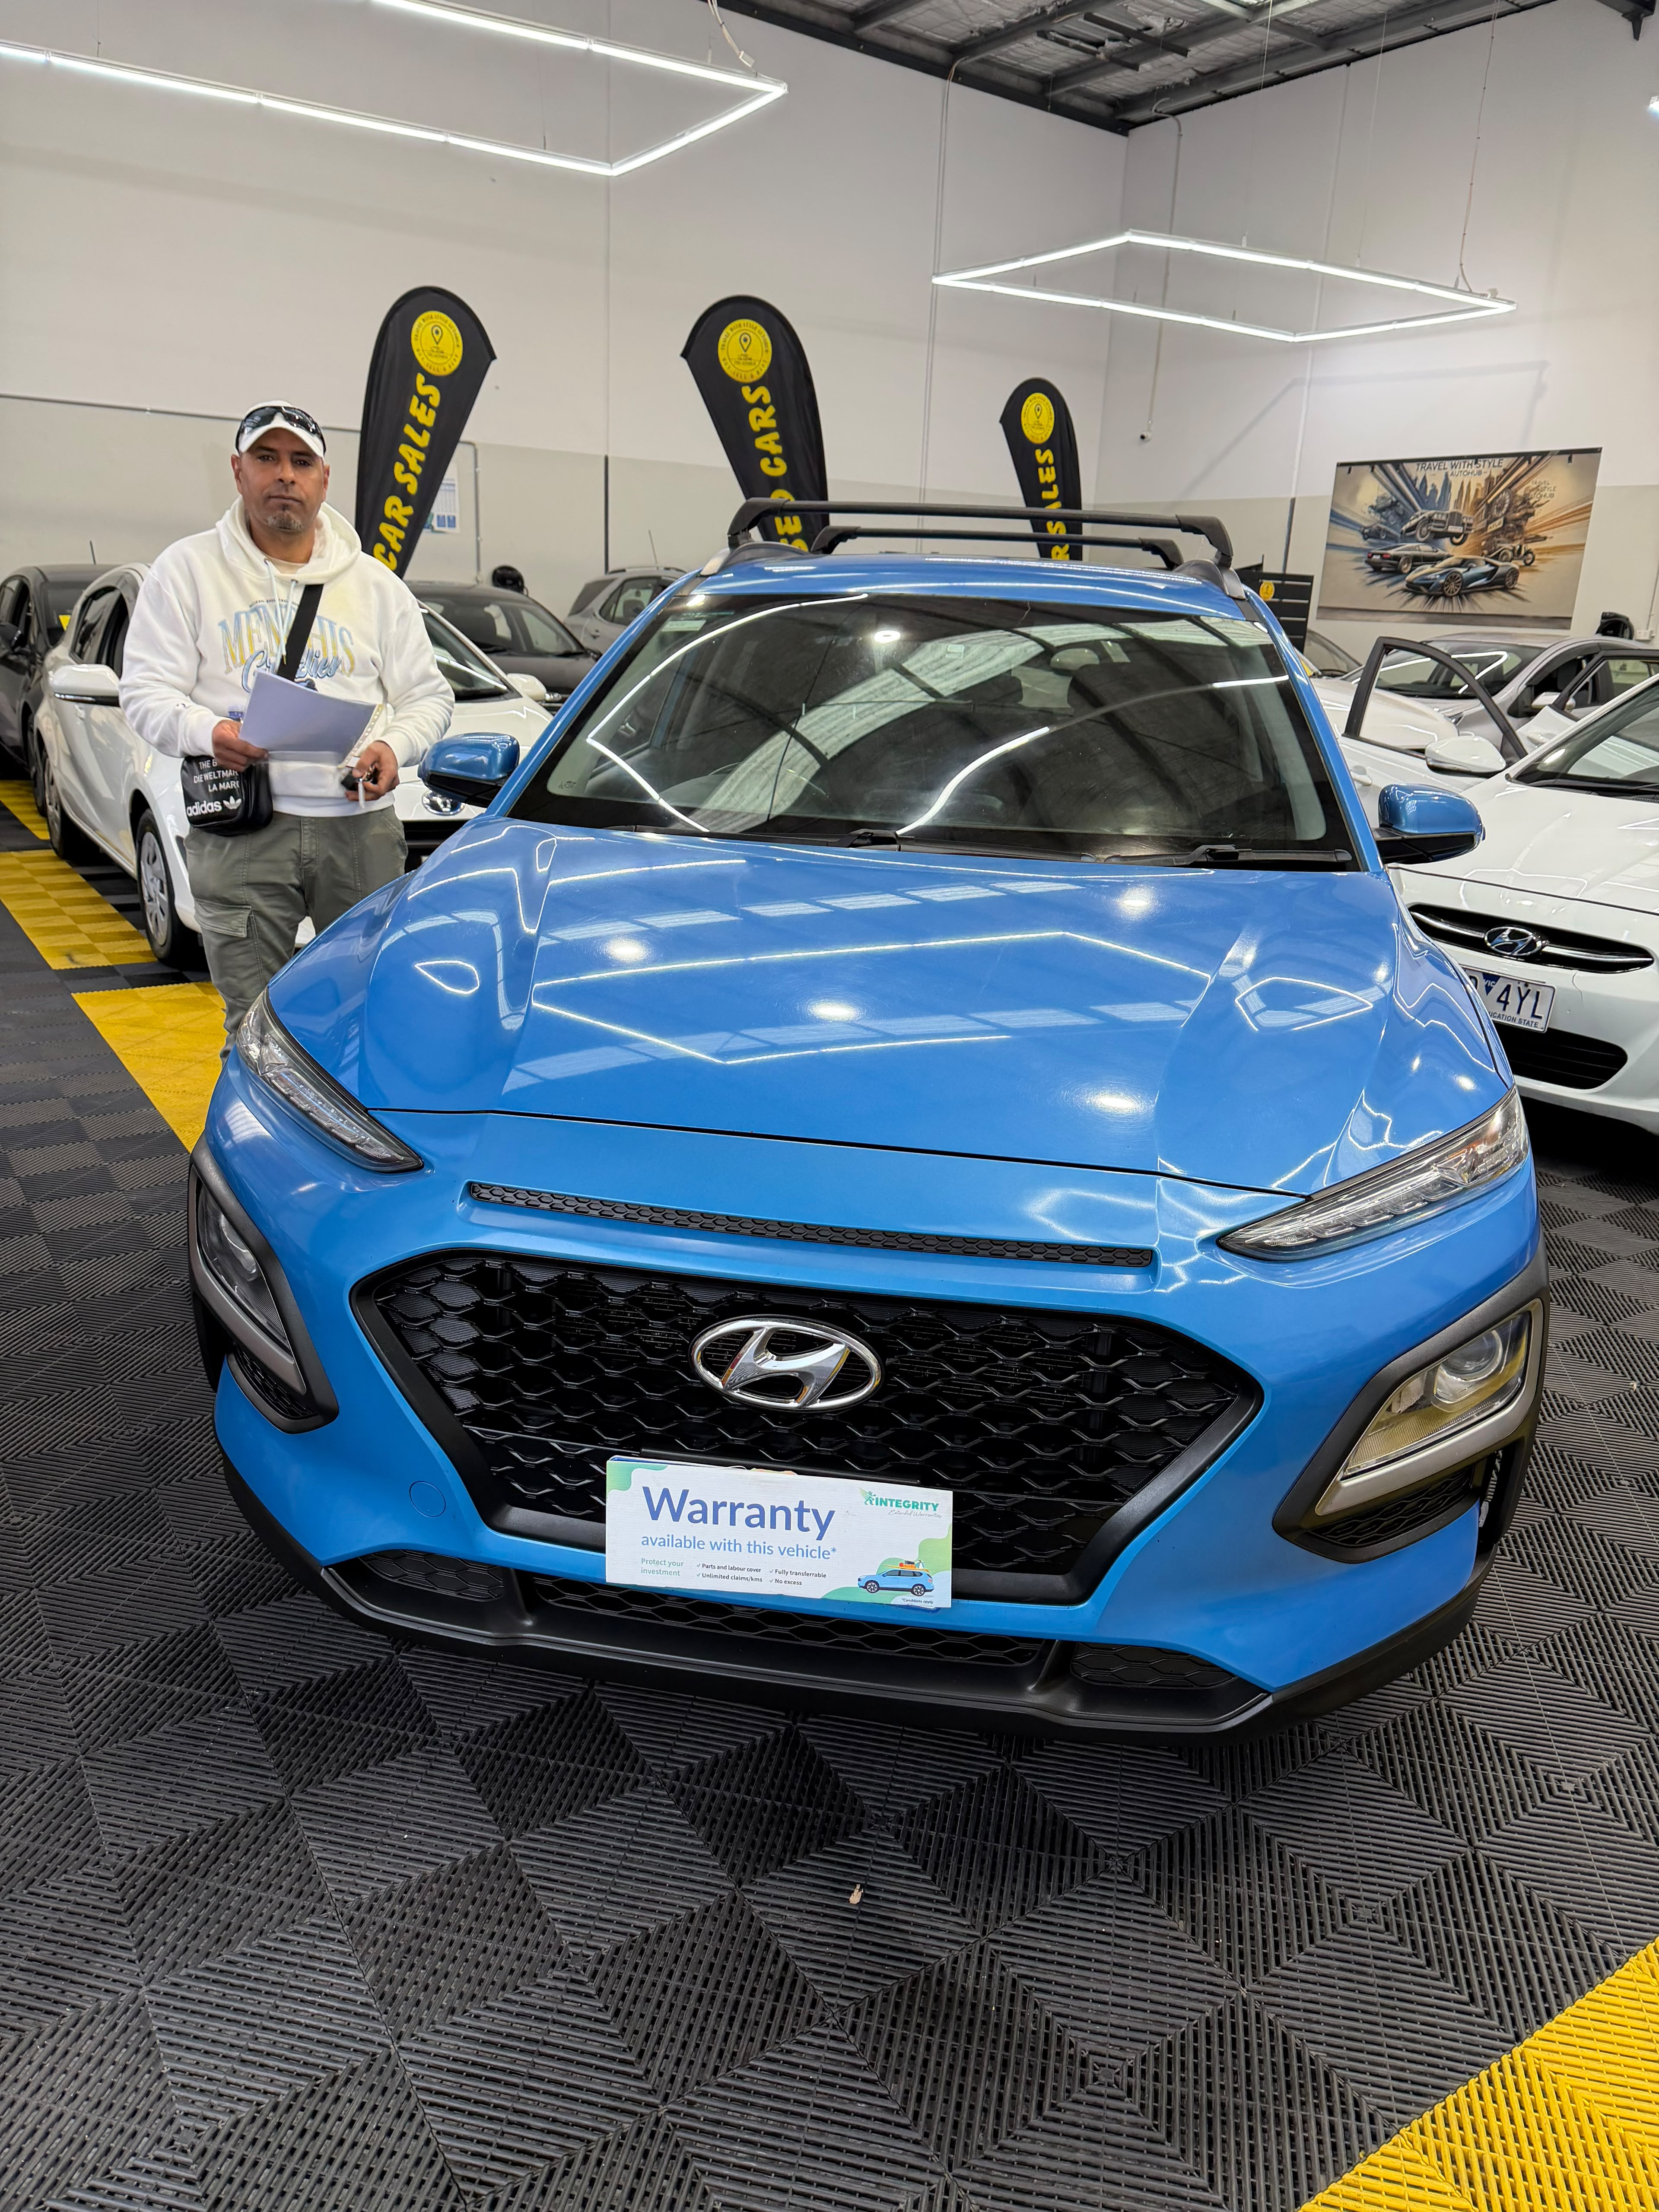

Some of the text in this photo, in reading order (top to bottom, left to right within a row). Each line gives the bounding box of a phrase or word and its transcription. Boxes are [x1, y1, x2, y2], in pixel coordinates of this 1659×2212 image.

[741, 385, 787, 477] CARS
[373, 495, 414, 571] CAR
[394, 372, 441, 495] SALES
[1416, 458, 1503, 471] TRAVEL WITH STYLE
[199, 760, 211, 770] THE
[194, 774, 203, 783] DIE
[208, 783, 218, 792] LA
[187, 800, 222, 817] adidas
[1497, 984, 1542, 1020] 4YL
[1519, 1018, 1539, 1027] STATE
[875, 1497, 939, 1511] INTEGRITY
[642, 1486, 836, 1541] Warranty
[642, 1535, 705, 1550] available
[709, 1538, 742, 1552] with
[747, 1541, 773, 1555] this
[641, 1567, 680, 1576] investment
